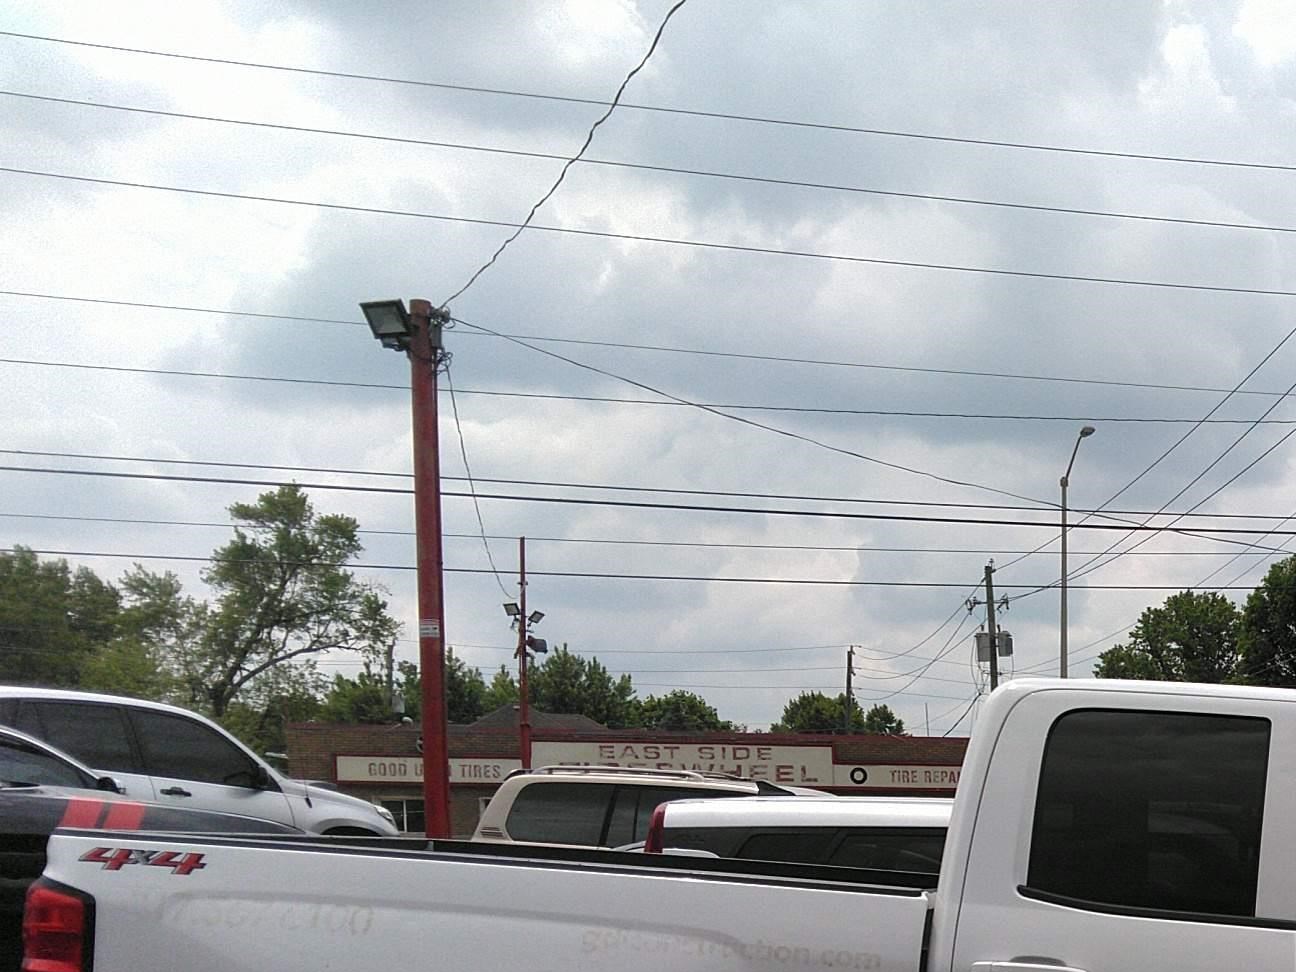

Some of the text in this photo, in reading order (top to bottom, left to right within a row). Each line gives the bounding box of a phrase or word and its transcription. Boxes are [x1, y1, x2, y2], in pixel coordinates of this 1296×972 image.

[598, 745, 773, 761] EAST SIDE
[368, 762, 407, 777] GOOD
[459, 764, 502, 779] TIRES
[889, 770, 918, 783] TIRE
